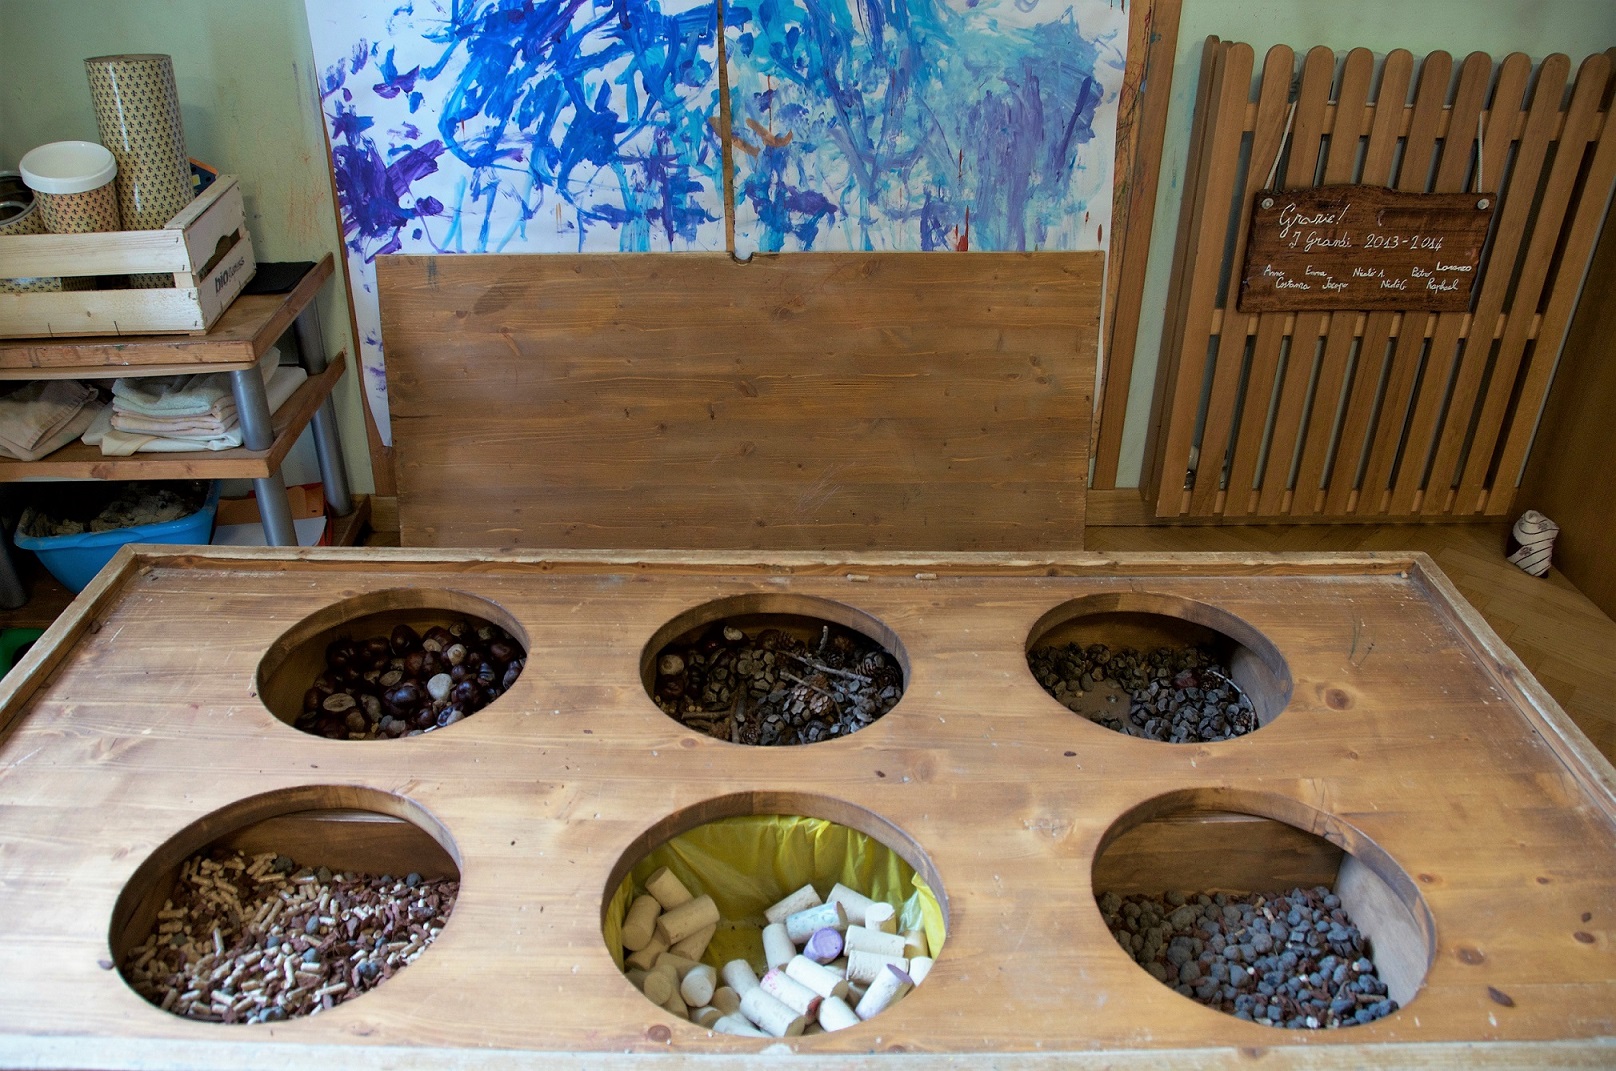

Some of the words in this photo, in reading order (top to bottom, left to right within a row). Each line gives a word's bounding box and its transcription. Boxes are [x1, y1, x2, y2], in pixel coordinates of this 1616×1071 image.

[1279, 202, 1351, 239] Grazie!
[1303, 231, 1352, 252] Grandi
[1435, 261, 1473, 272] Lorenzo
